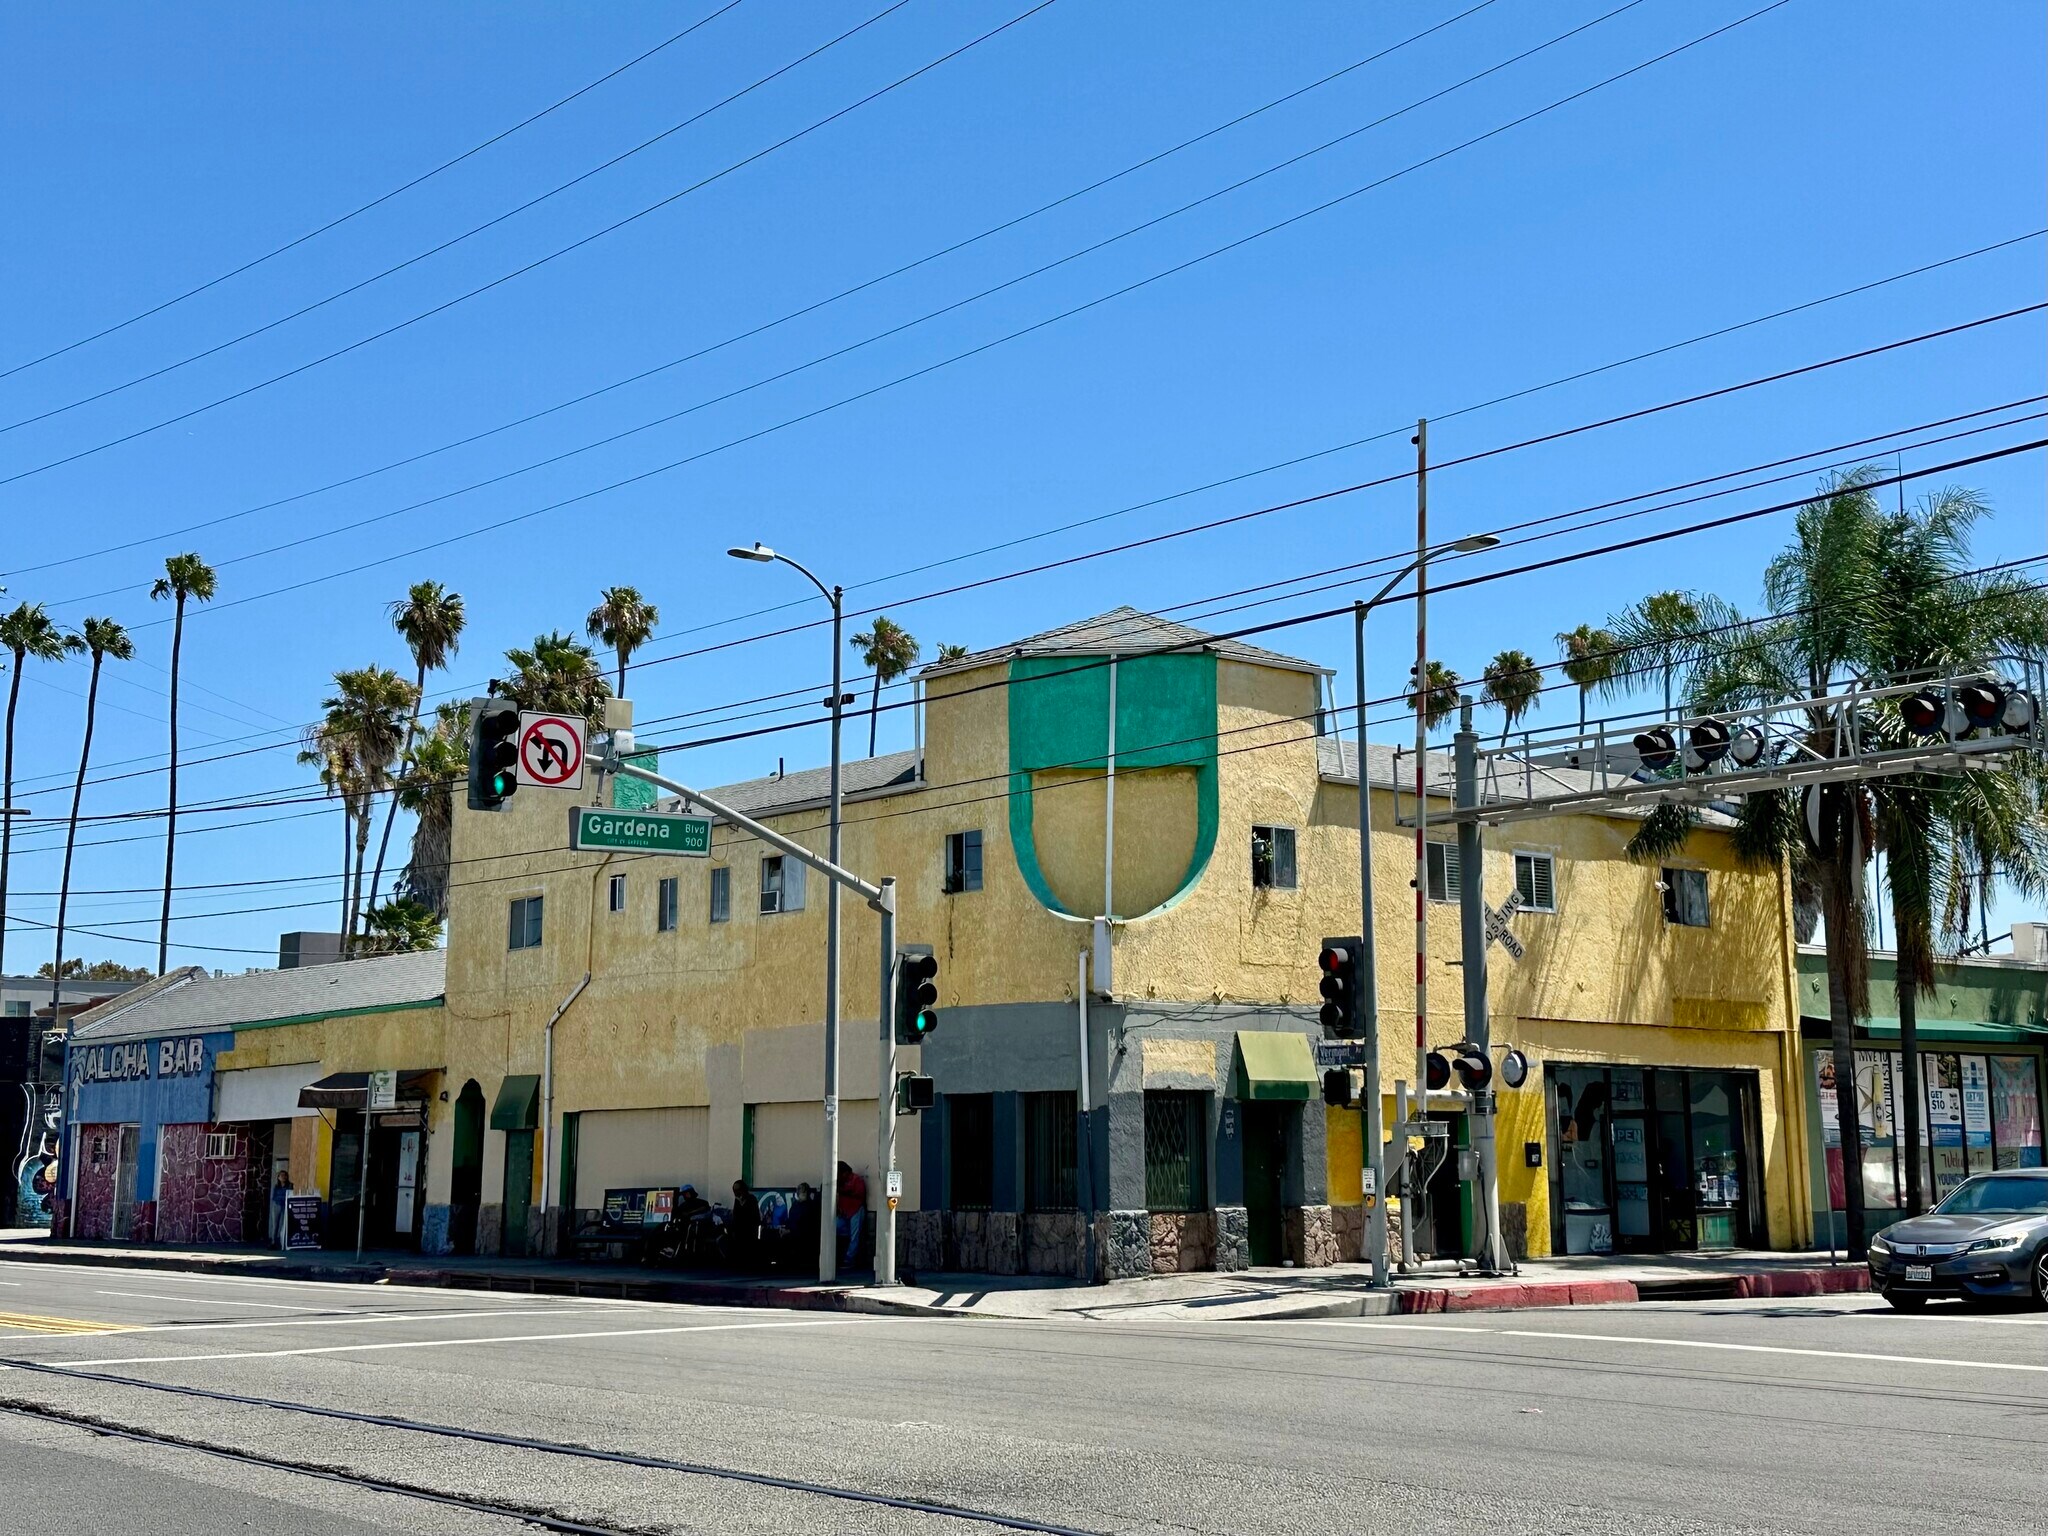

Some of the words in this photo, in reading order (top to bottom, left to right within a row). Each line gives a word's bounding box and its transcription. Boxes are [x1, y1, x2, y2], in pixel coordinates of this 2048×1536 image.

[588, 815, 669, 839] Gardena
[685, 823, 705, 835] Blvd
[685, 837, 703, 848] 900
[1499, 929, 1522, 958] ROAD
[85, 1042, 150, 1082] ALOHA
[158, 1037, 204, 1077] BAR
[1320, 1047, 1350, 1058] Vermont
[1930, 1091, 1943, 1099] GET
[1616, 1129, 1642, 1144] PEN
